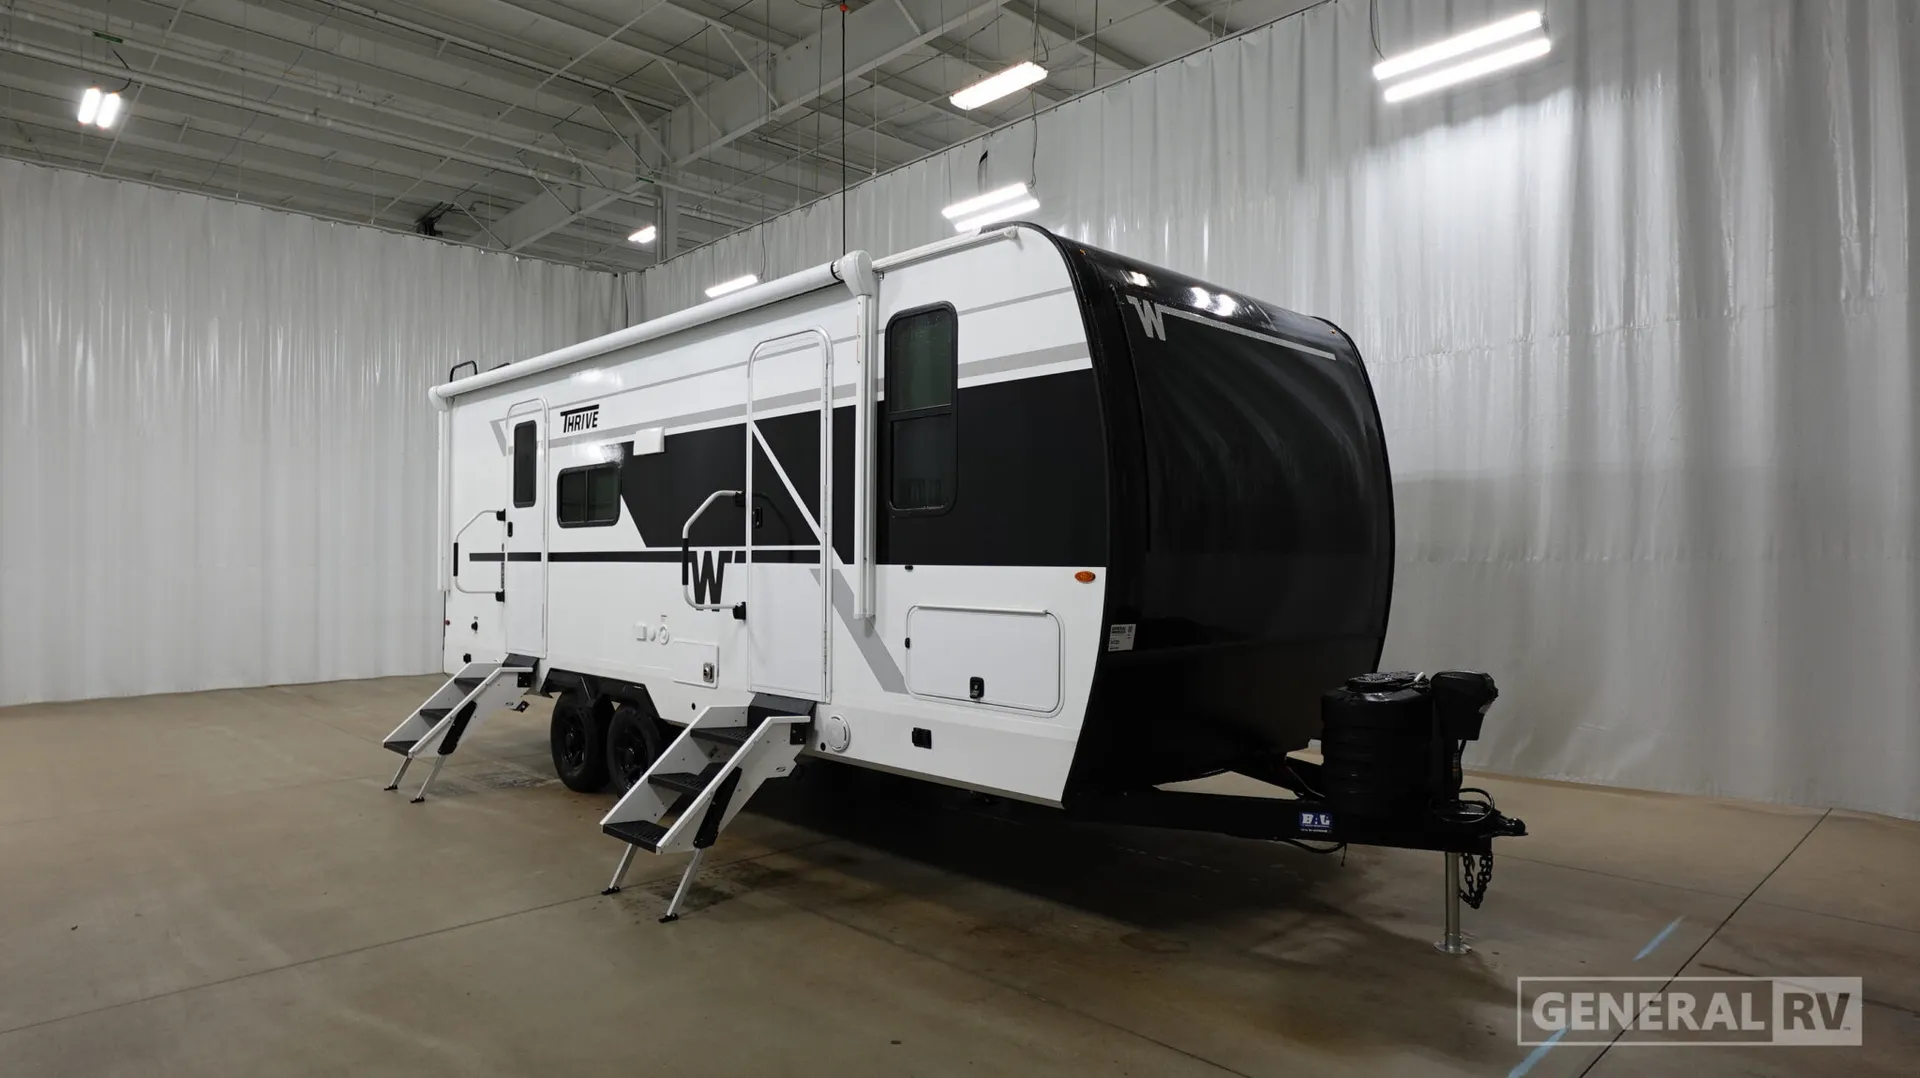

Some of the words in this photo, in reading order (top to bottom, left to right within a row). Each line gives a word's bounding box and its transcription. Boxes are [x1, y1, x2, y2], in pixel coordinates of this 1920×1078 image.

[1126, 295, 1166, 341] W
[560, 404, 600, 433] THRIVE
[689, 551, 733, 612] W
